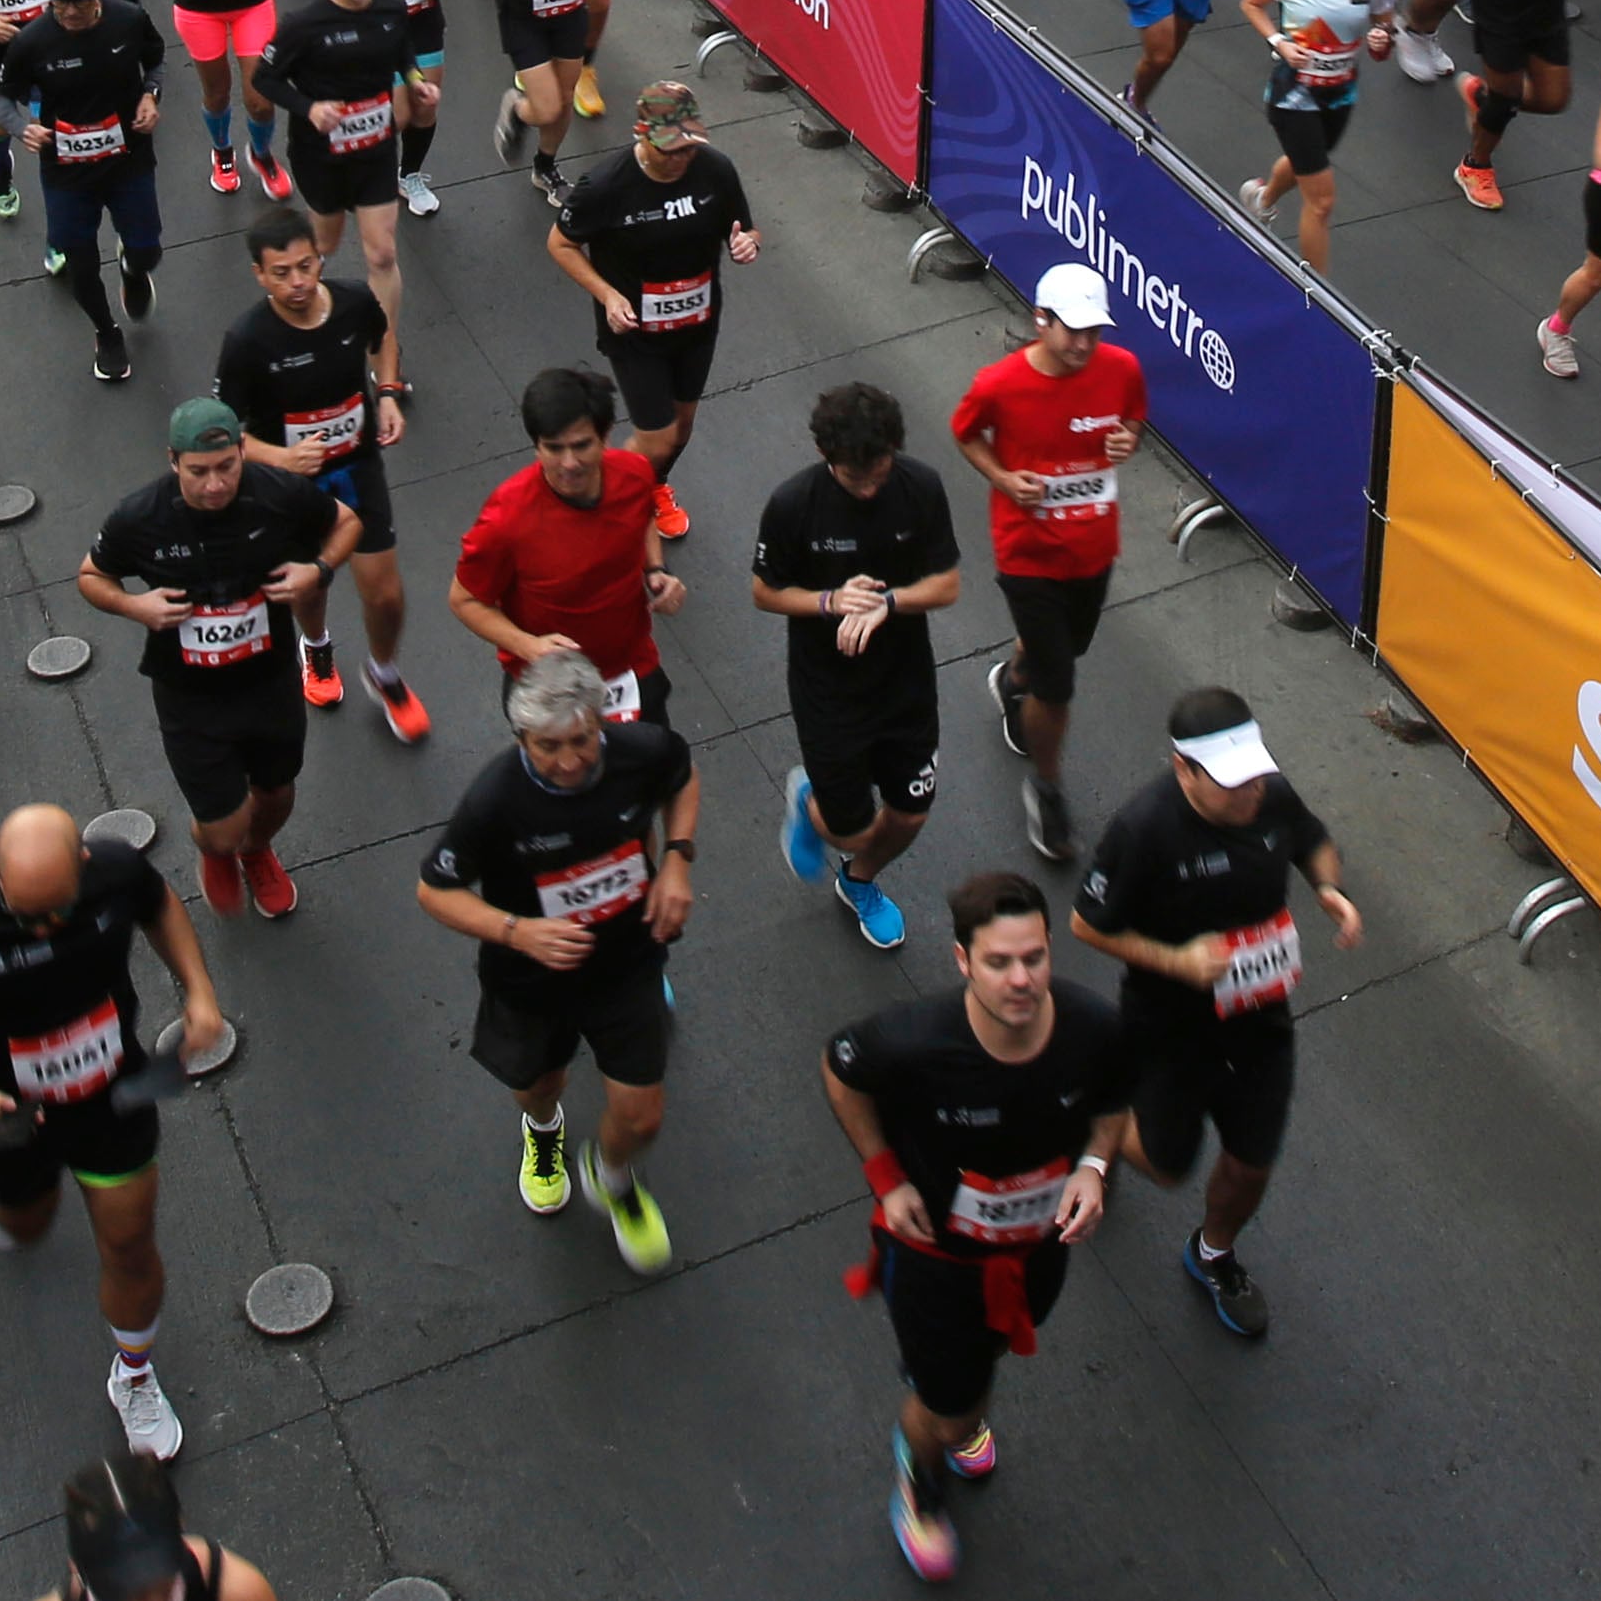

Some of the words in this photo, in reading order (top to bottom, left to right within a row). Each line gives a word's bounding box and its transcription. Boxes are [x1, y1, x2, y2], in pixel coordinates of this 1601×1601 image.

[66, 134, 117, 153] 16234
[663, 195, 696, 222] 21K
[1022, 155, 1236, 392] publimetro
[653, 293, 707, 315] 15353
[192, 616, 257, 643] 16267
